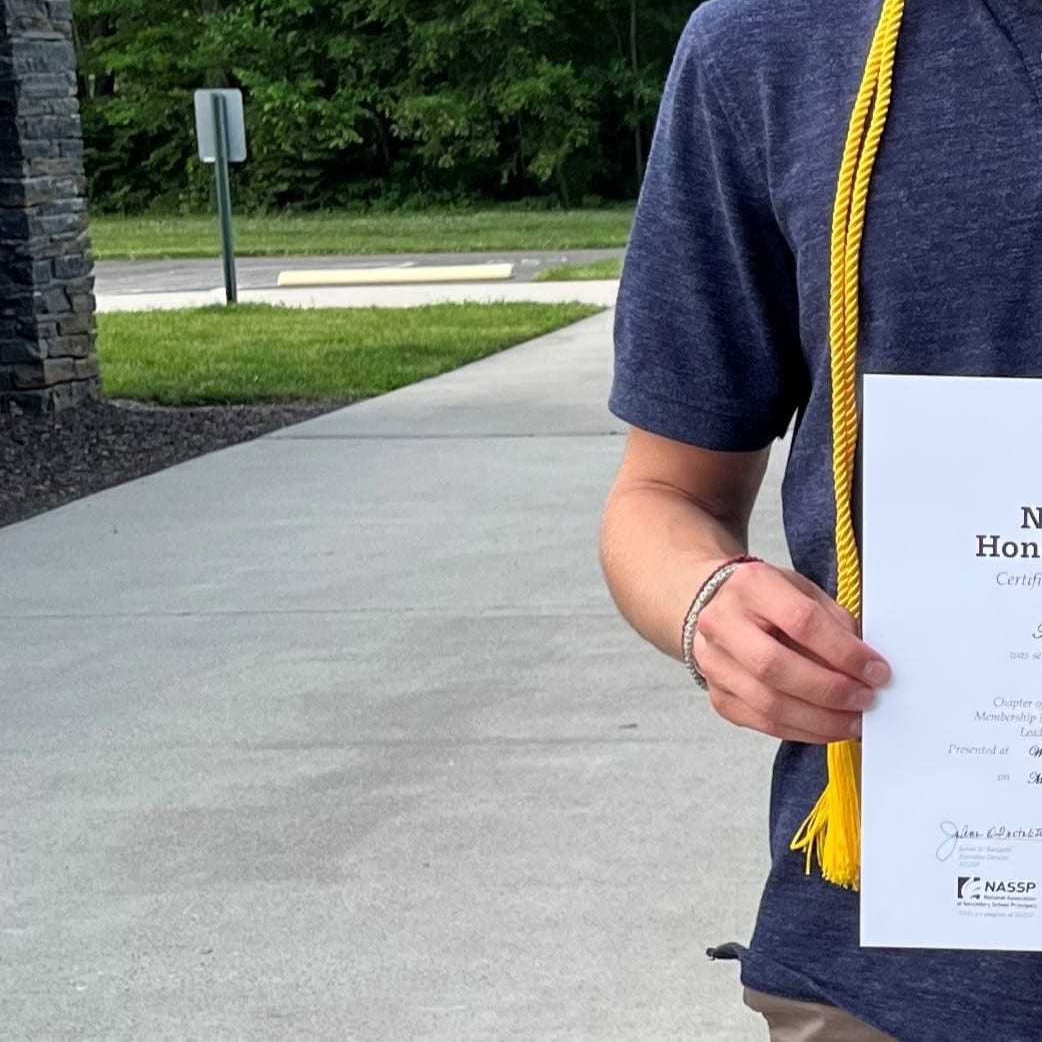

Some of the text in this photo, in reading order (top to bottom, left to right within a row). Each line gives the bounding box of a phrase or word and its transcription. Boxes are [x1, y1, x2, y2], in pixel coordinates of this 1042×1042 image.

[1009, 651, 1029, 660] was
[992, 697, 1033, 711] Chapter
[974, 711, 1037, 725] Membership
[947, 743, 997, 756] Presented
[999, 746, 1010, 756] at
[997, 773, 1010, 782] on
[984, 880, 1036, 894] NASSP
